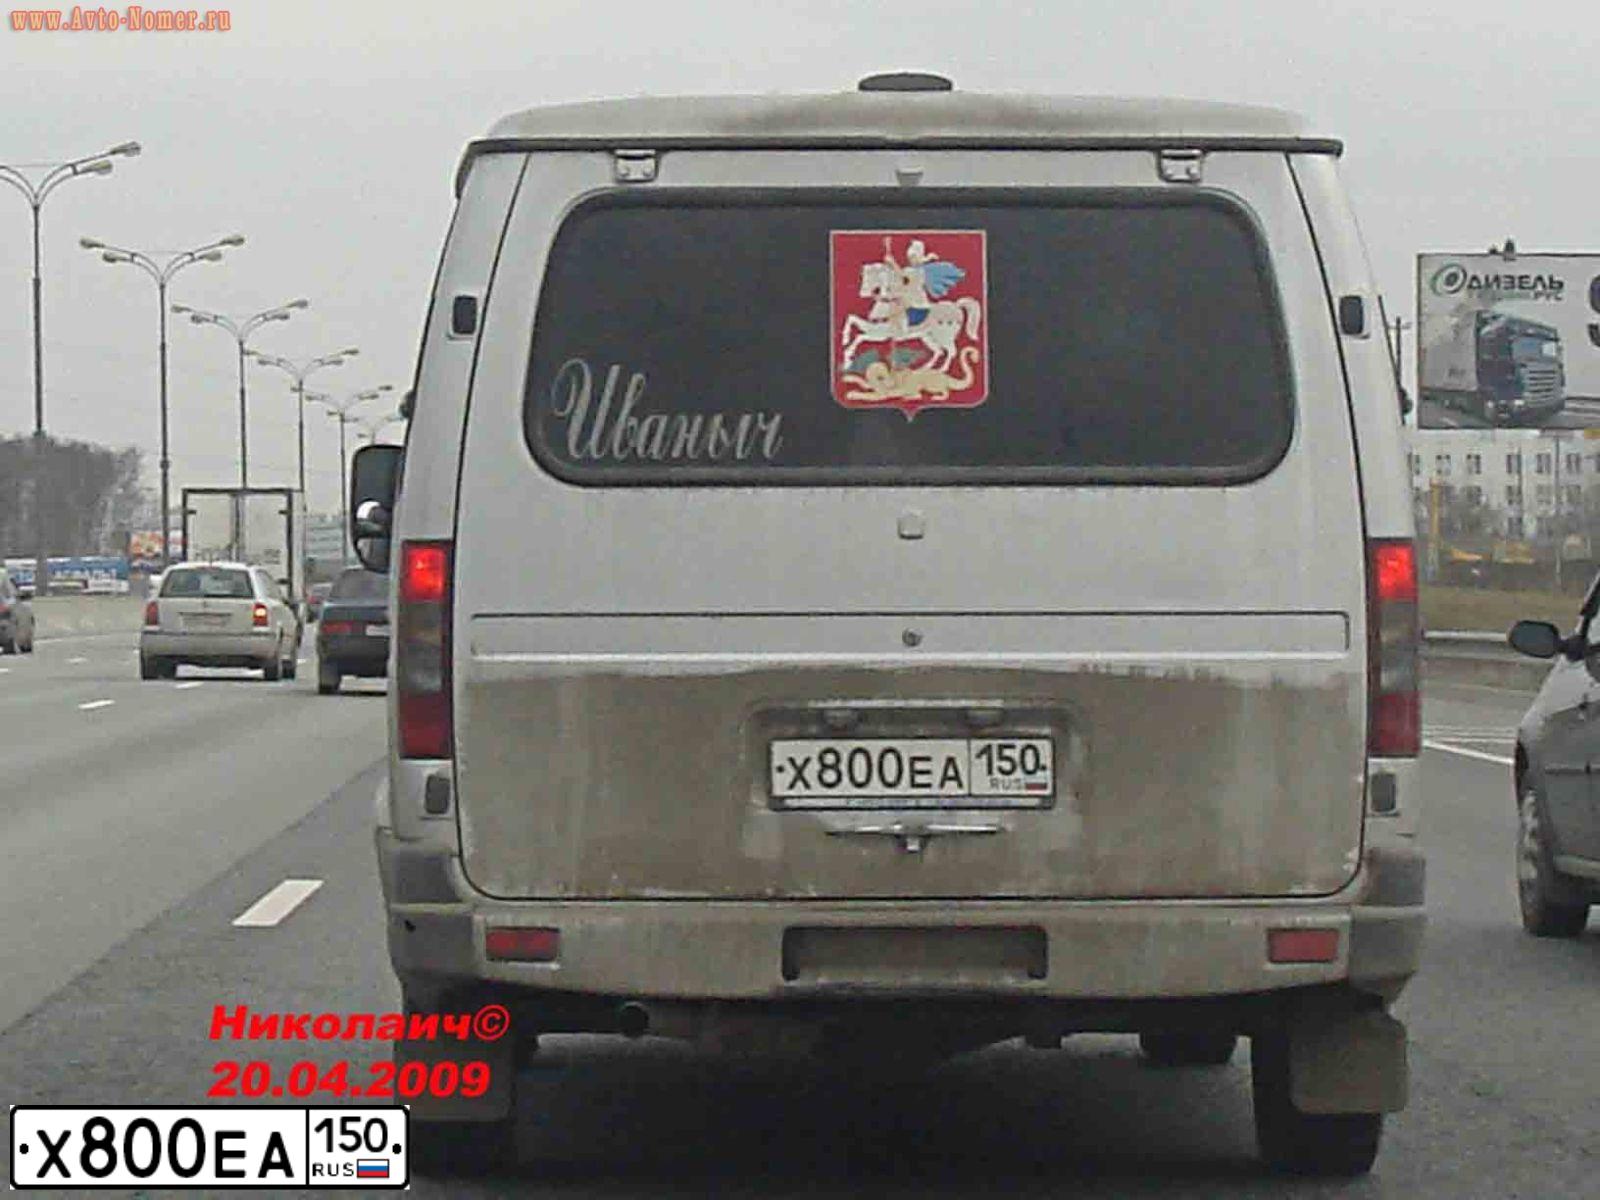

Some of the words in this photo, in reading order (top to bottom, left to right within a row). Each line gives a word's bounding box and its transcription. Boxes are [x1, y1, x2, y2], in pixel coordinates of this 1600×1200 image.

[552, 358, 784, 459] Иваныч
[975, 743, 1041, 777] 150
[989, 778, 1022, 790] RUS
